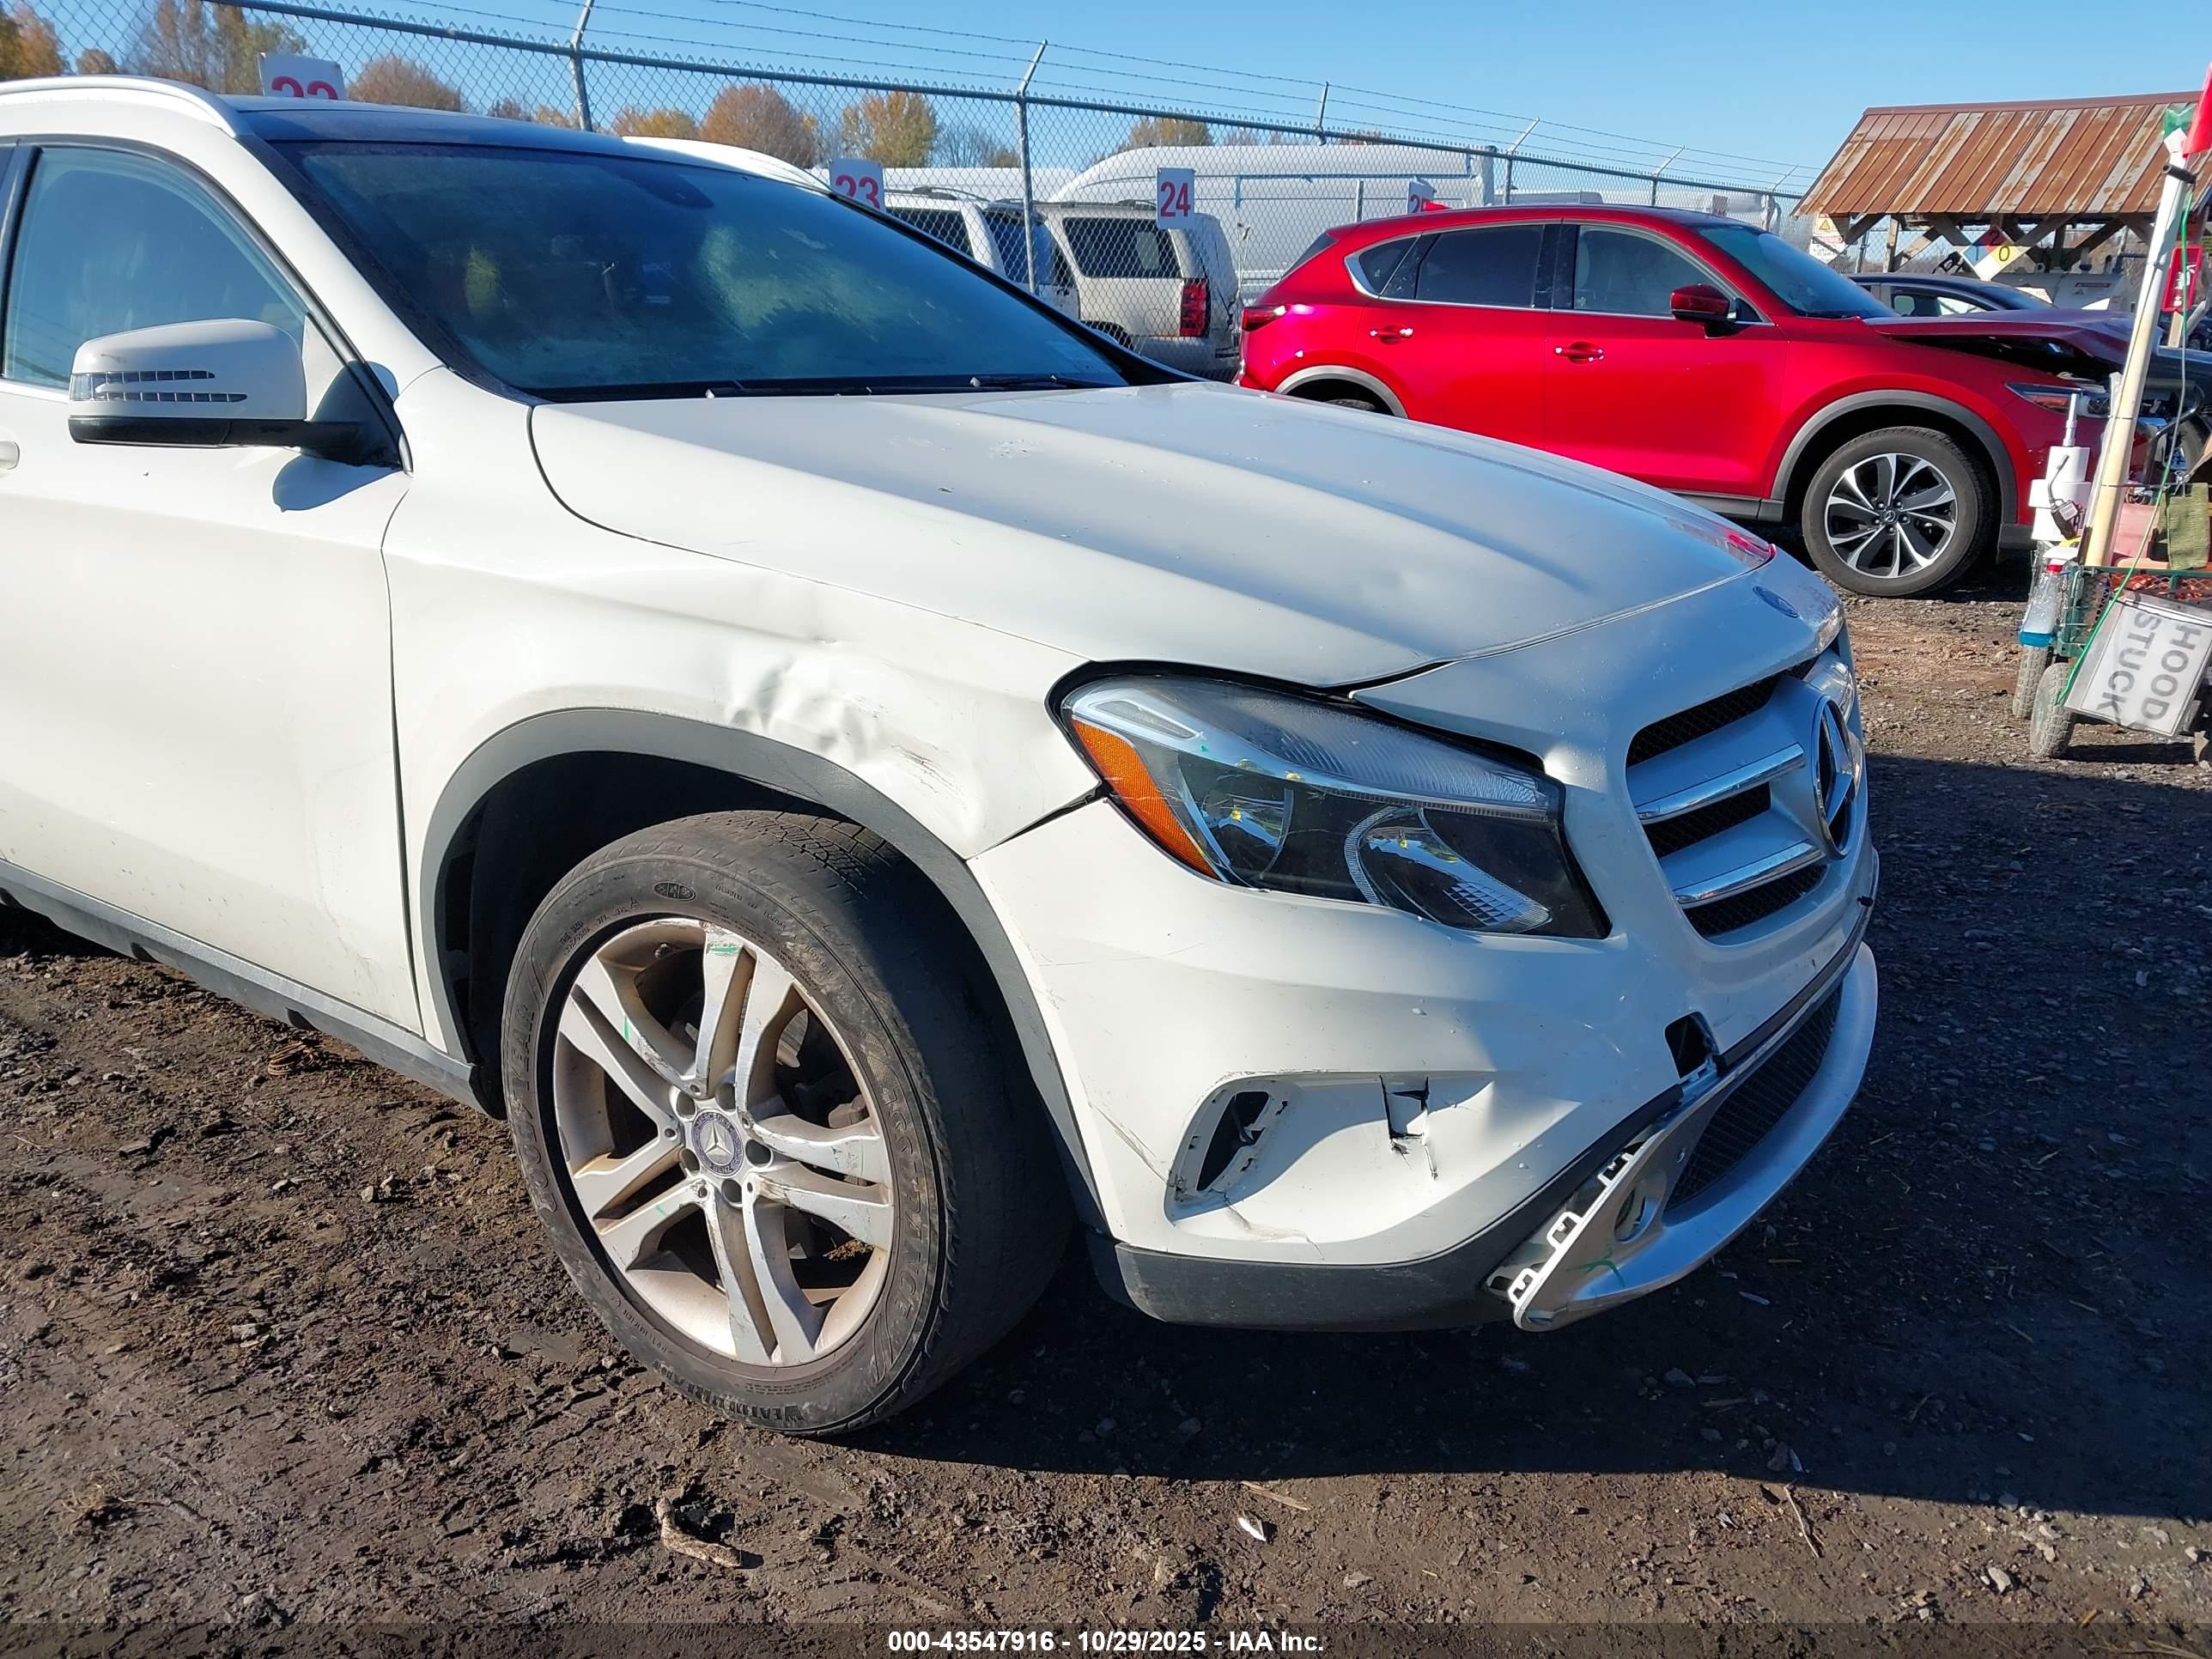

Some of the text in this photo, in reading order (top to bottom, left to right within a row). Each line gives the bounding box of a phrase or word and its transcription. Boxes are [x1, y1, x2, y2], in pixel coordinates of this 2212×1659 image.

[1160, 181, 1191, 217] 24
[1998, 246, 2010, 262] 0
[2097, 611, 2162, 718] STUCK
[2141, 623, 2202, 720] HOOD
